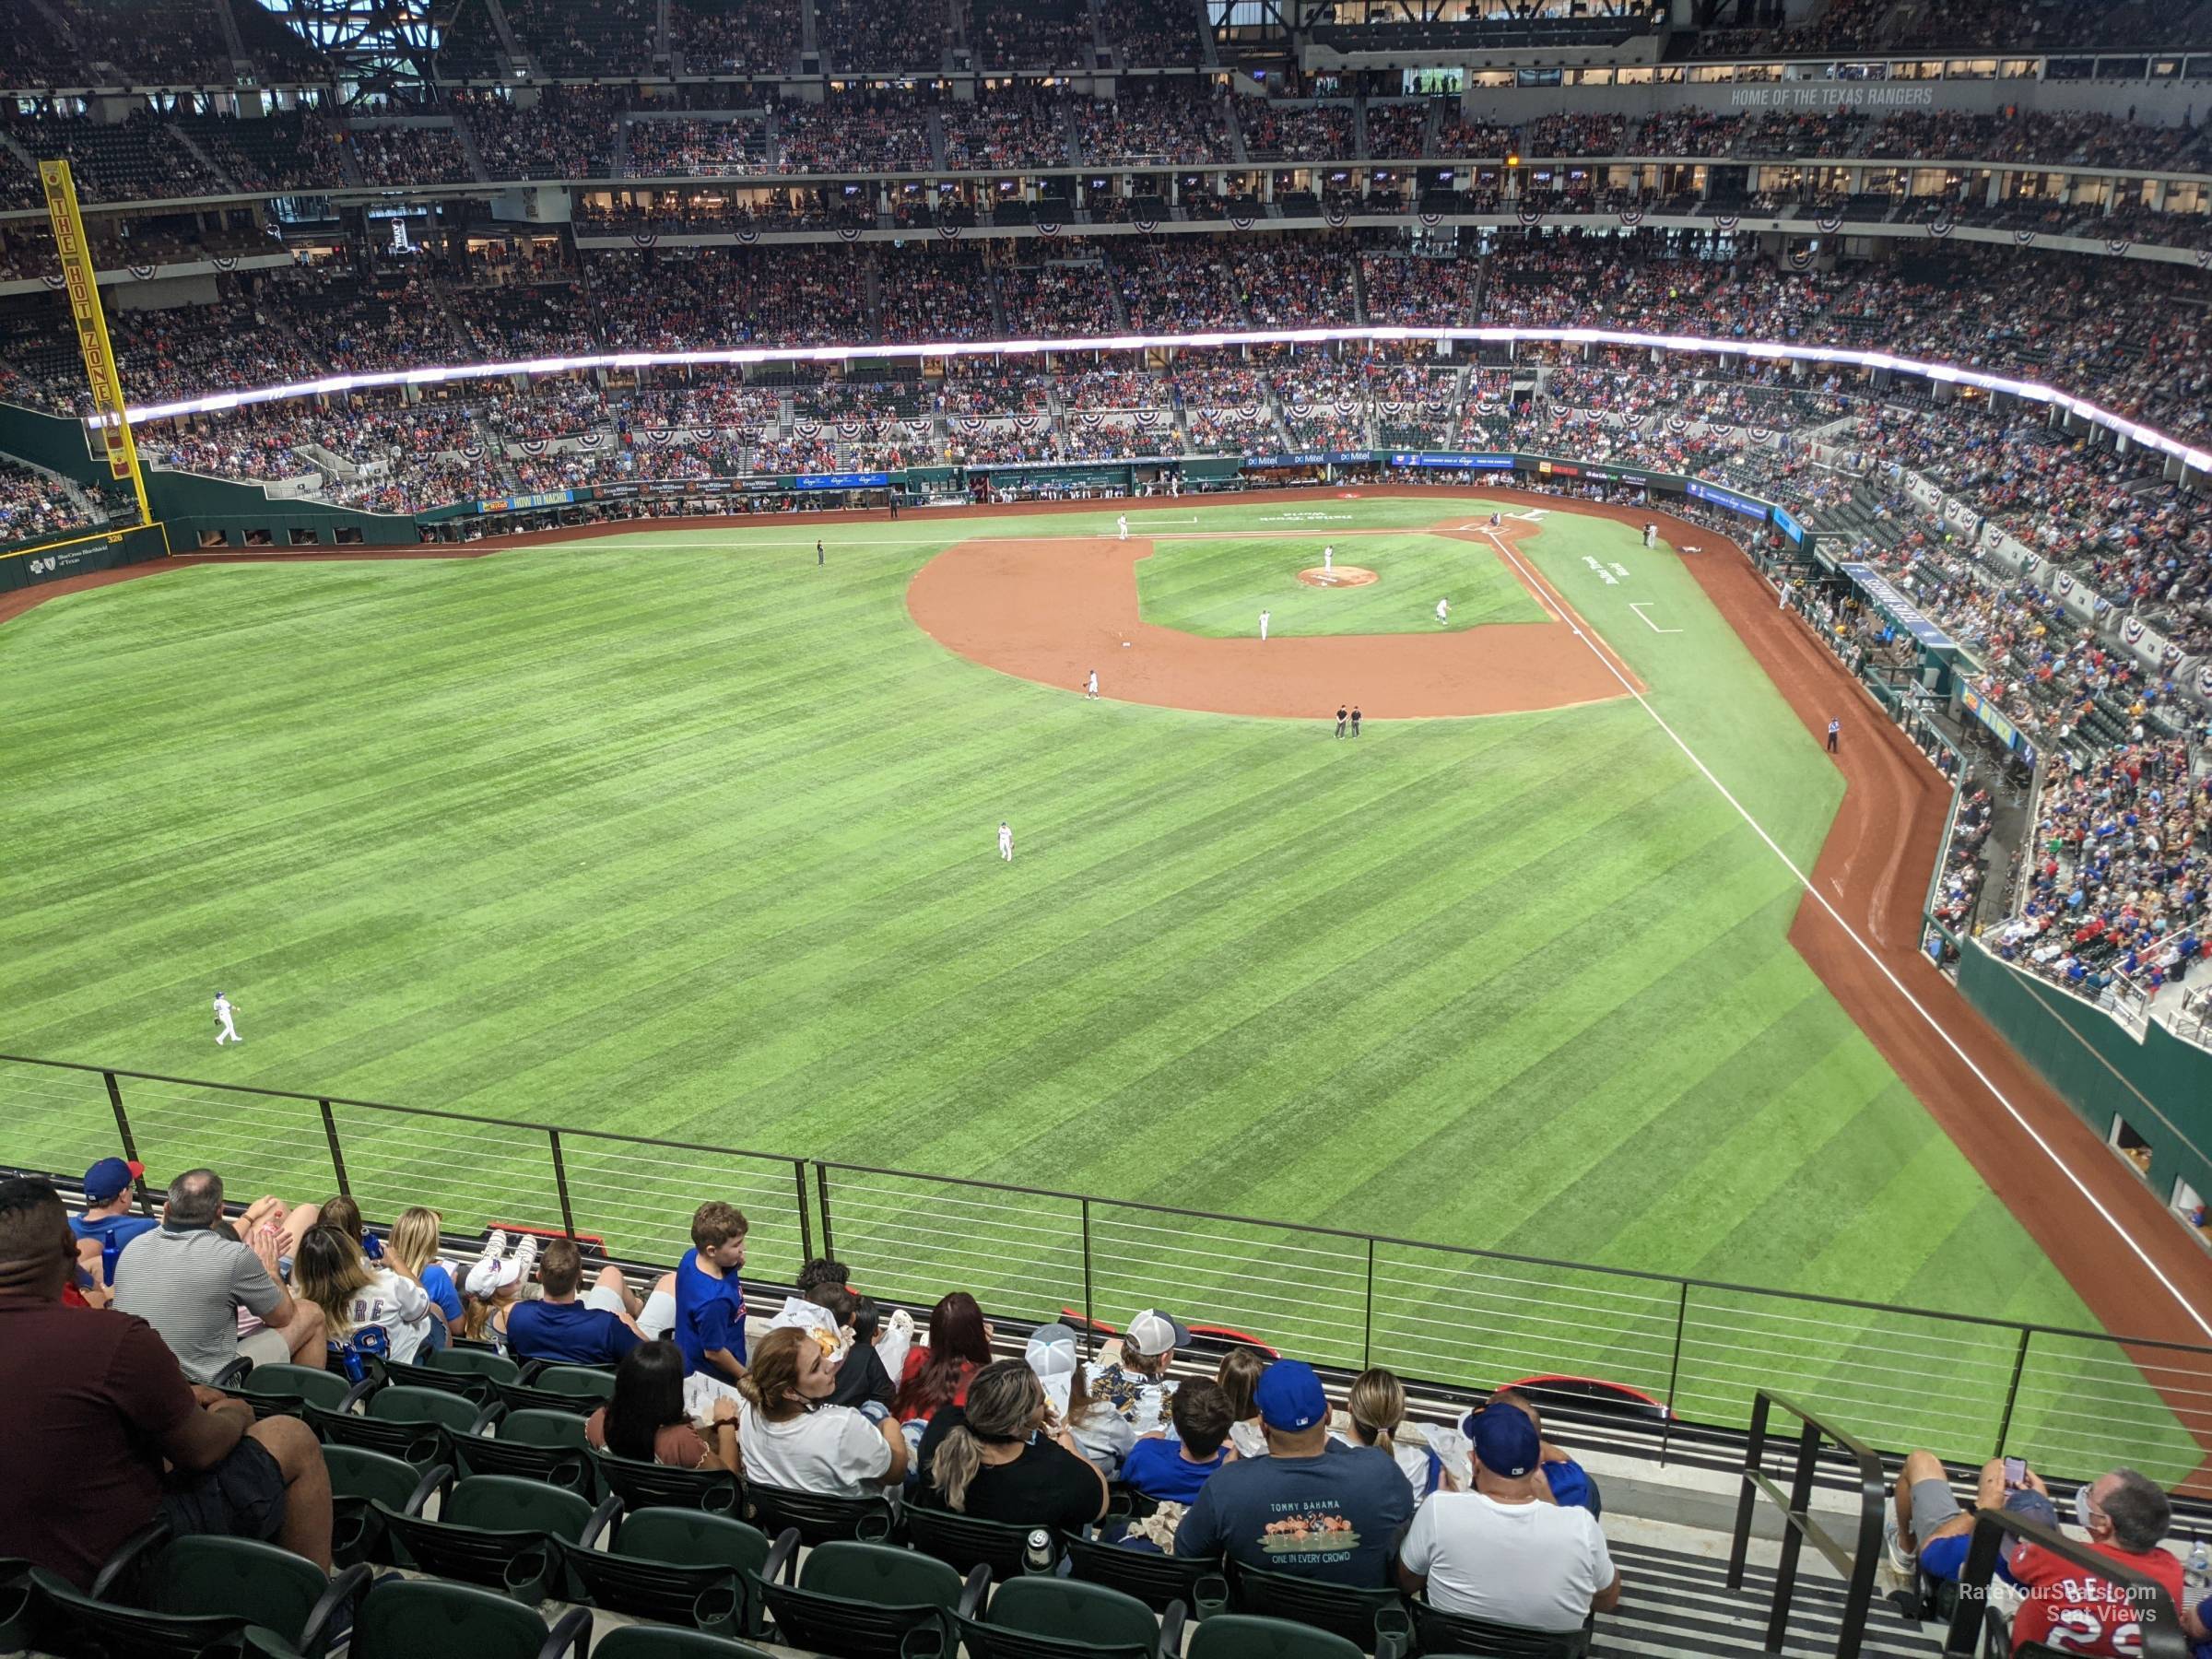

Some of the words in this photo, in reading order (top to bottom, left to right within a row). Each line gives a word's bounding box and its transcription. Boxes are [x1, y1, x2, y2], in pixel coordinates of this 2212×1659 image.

[1731, 88, 1769, 106] HOME
[1771, 88, 1789, 105] OF
[1794, 88, 1817, 105] THE
[1821, 88, 1864, 105] TEXAS
[1867, 87, 1933, 105] RANGERS
[393, 224, 404, 249] TRULY
[53, 199, 75, 253] THE
[68, 266, 89, 319] HOT
[84, 332, 111, 400] ZONE
[1258, 456, 1278, 465] Mitel
[1304, 453, 1324, 463] Mitel
[1350, 452, 1371, 461] Mitel
[513, 496, 532, 509] HOW
[534, 495, 542, 506] TO
[1270, 1502, 1299, 1512] TOMMY
[1303, 1500, 1340, 1511] BAHAMA
[1272, 1554, 1288, 1564] ONE
[1288, 1554, 1297, 1563] IN
[1298, 1553, 1321, 1563] EVERY
[1322, 1551, 1350, 1563] CROWD
